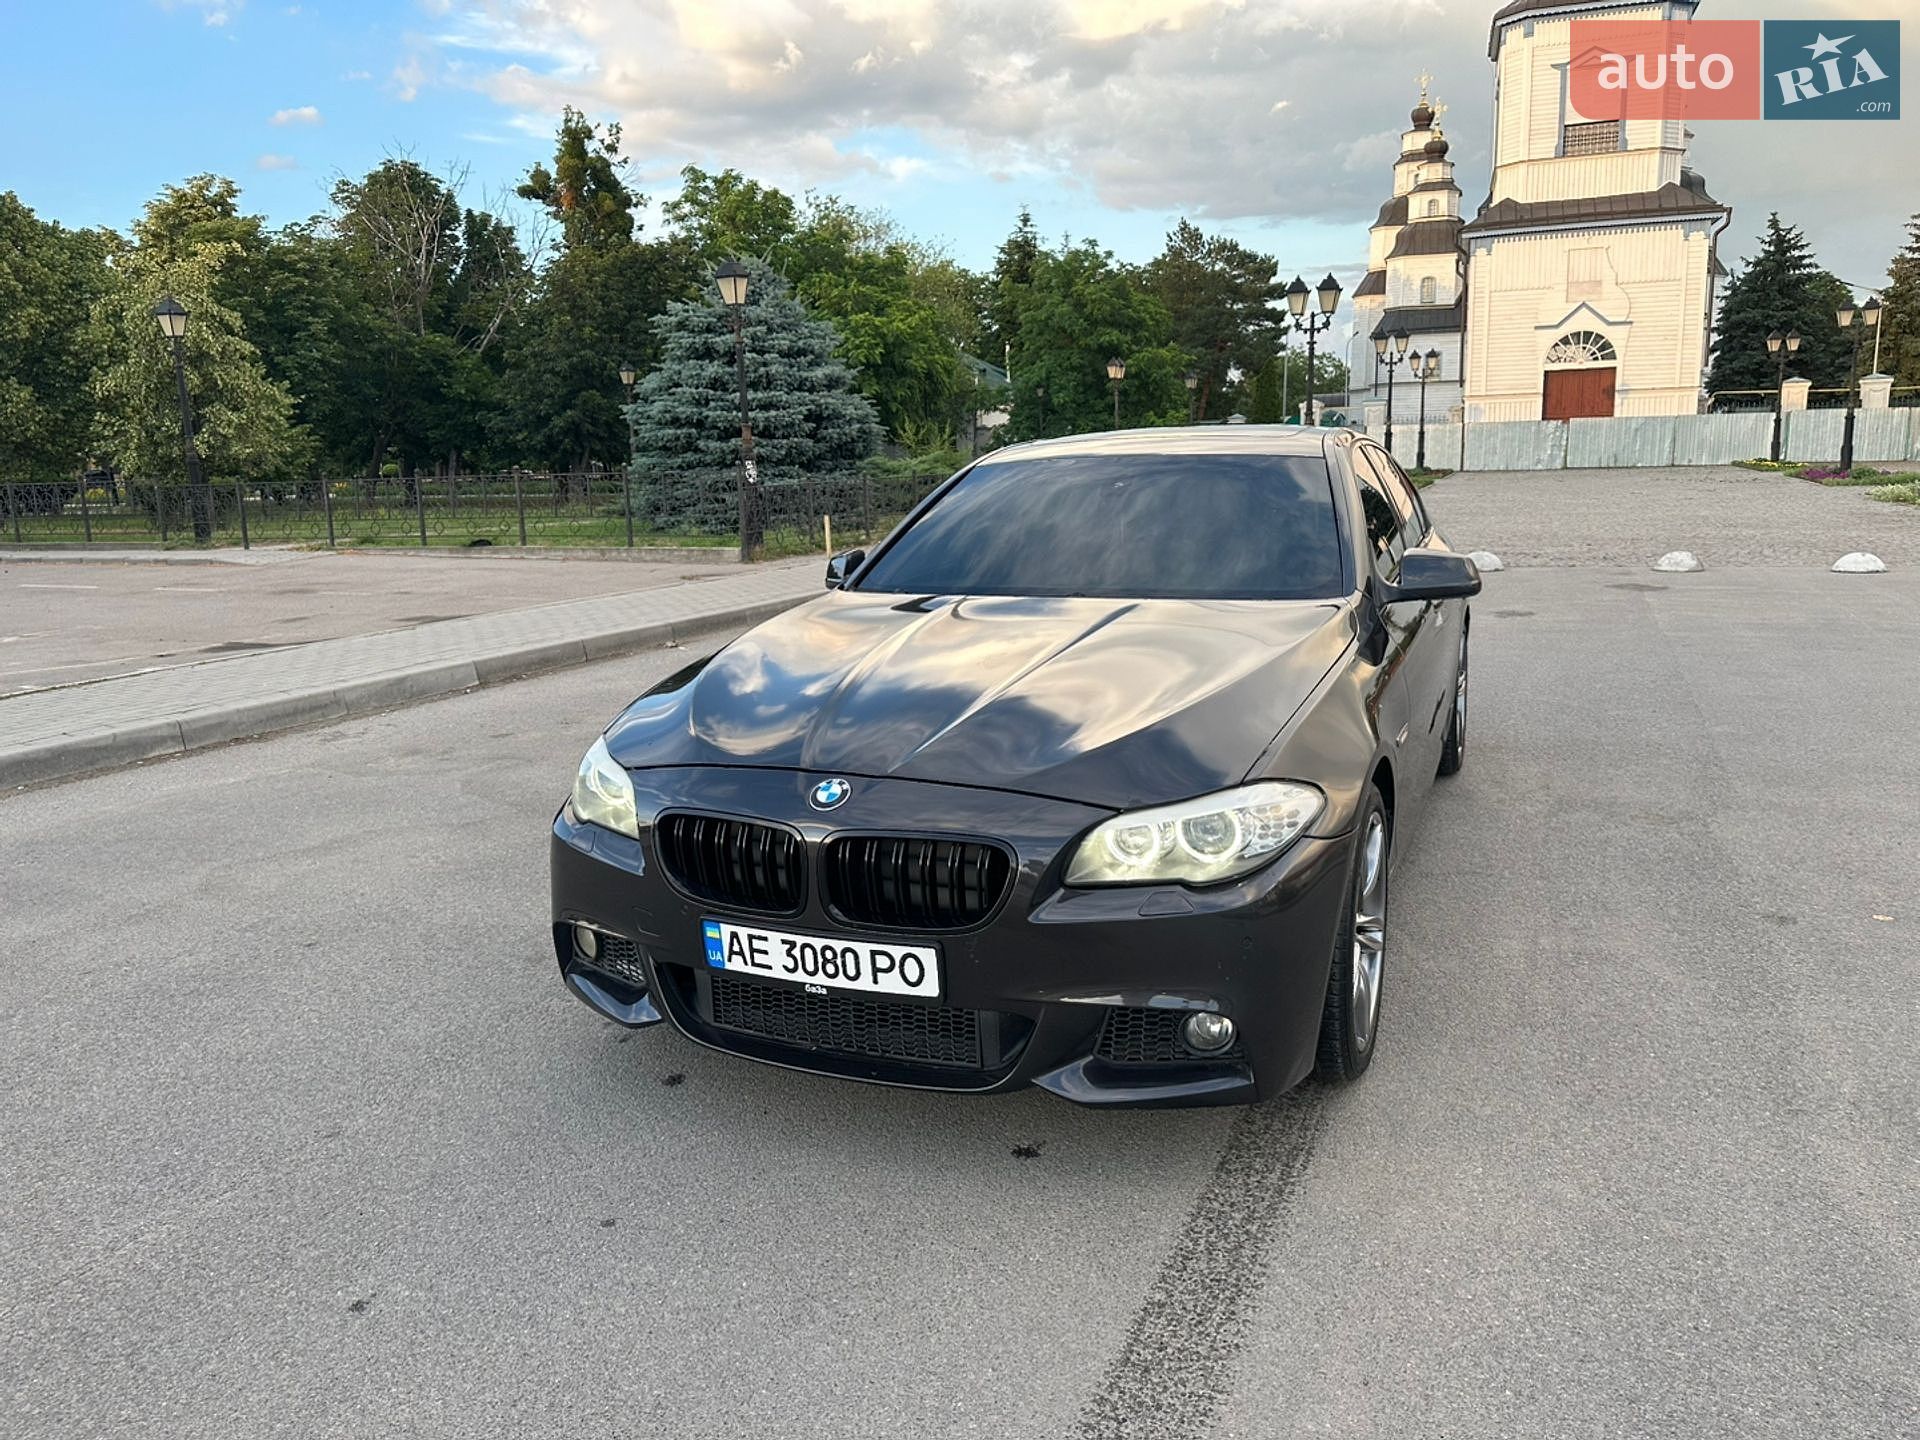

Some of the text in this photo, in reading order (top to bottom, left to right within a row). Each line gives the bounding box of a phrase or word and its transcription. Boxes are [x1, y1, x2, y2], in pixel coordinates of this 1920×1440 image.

[708, 950, 723, 962] UA
[728, 931, 925, 987] AE 3080 PO
